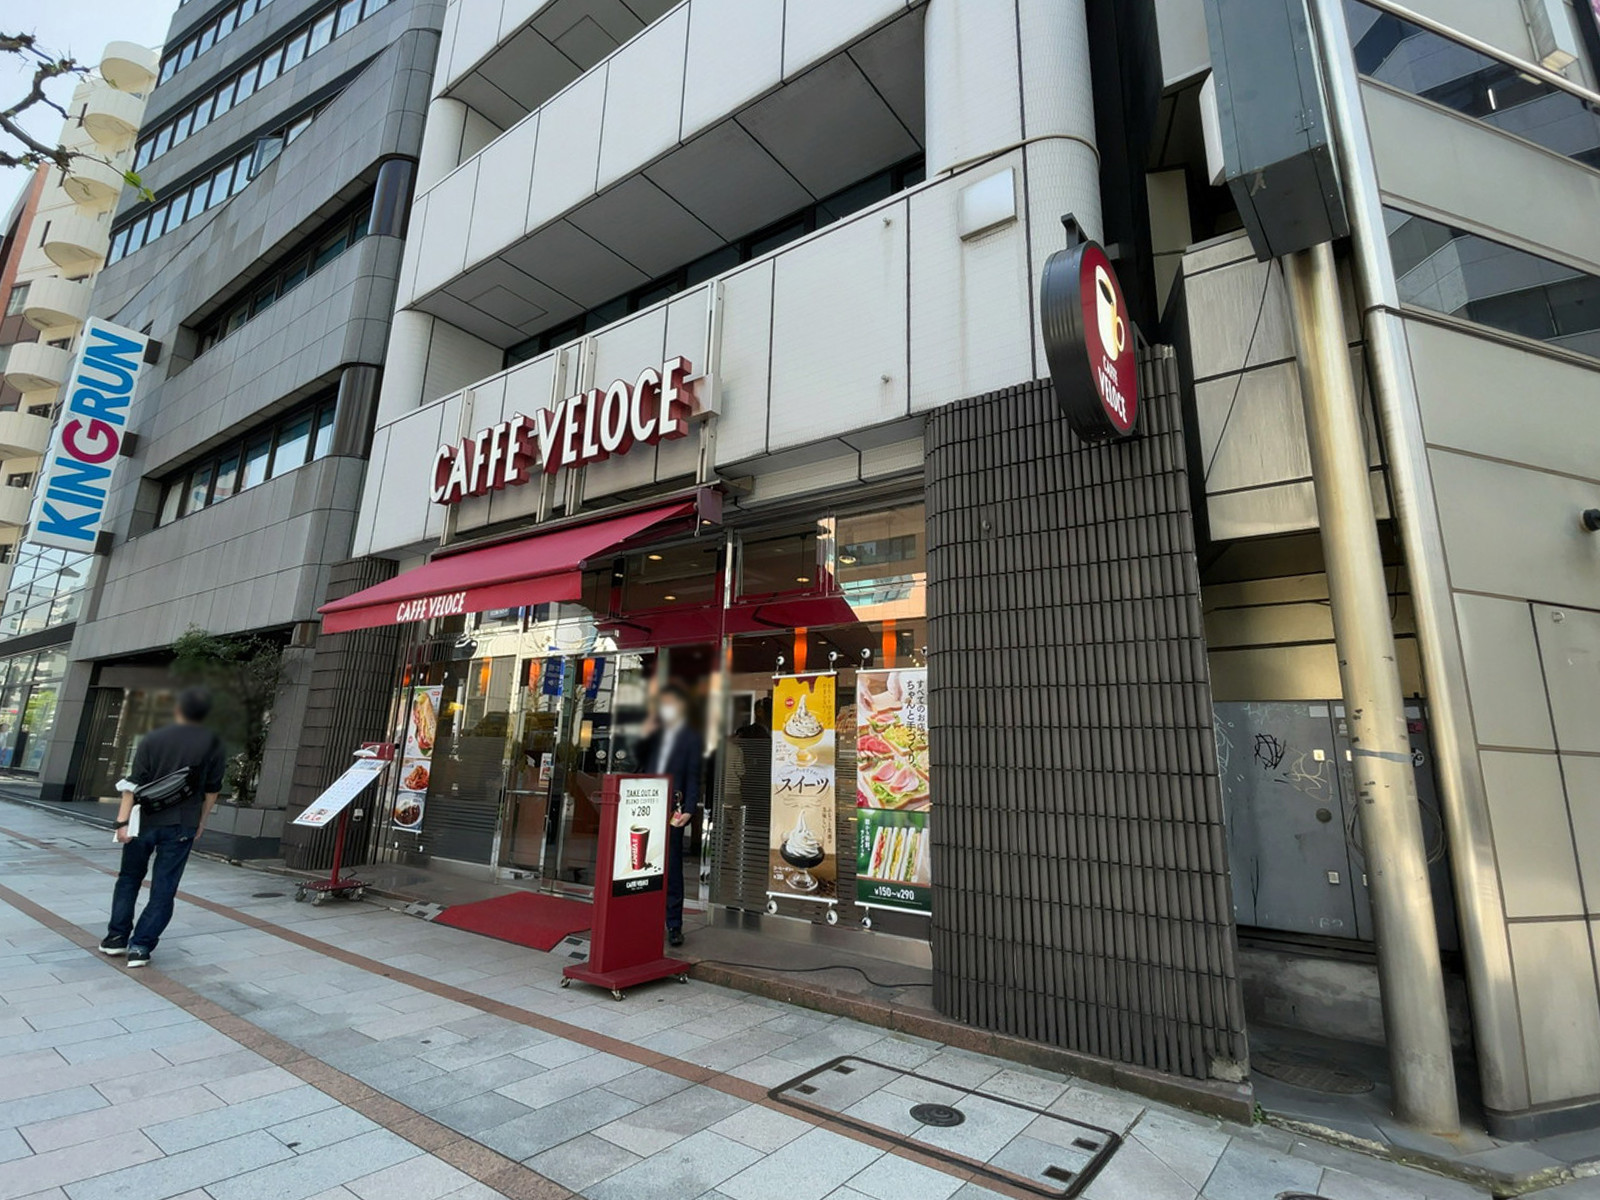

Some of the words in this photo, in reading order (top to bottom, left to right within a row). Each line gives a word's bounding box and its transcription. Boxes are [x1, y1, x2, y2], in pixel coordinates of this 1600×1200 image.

[536, 356, 690, 473] VELOCE
[1097, 366, 1128, 423] VELOCE
[37, 327, 144, 542] KINGRUN
[428, 592, 467, 618] VELOCE
[774, 775, 830, 796] スイーツ
[631, 805, 651, 817] ¥280
